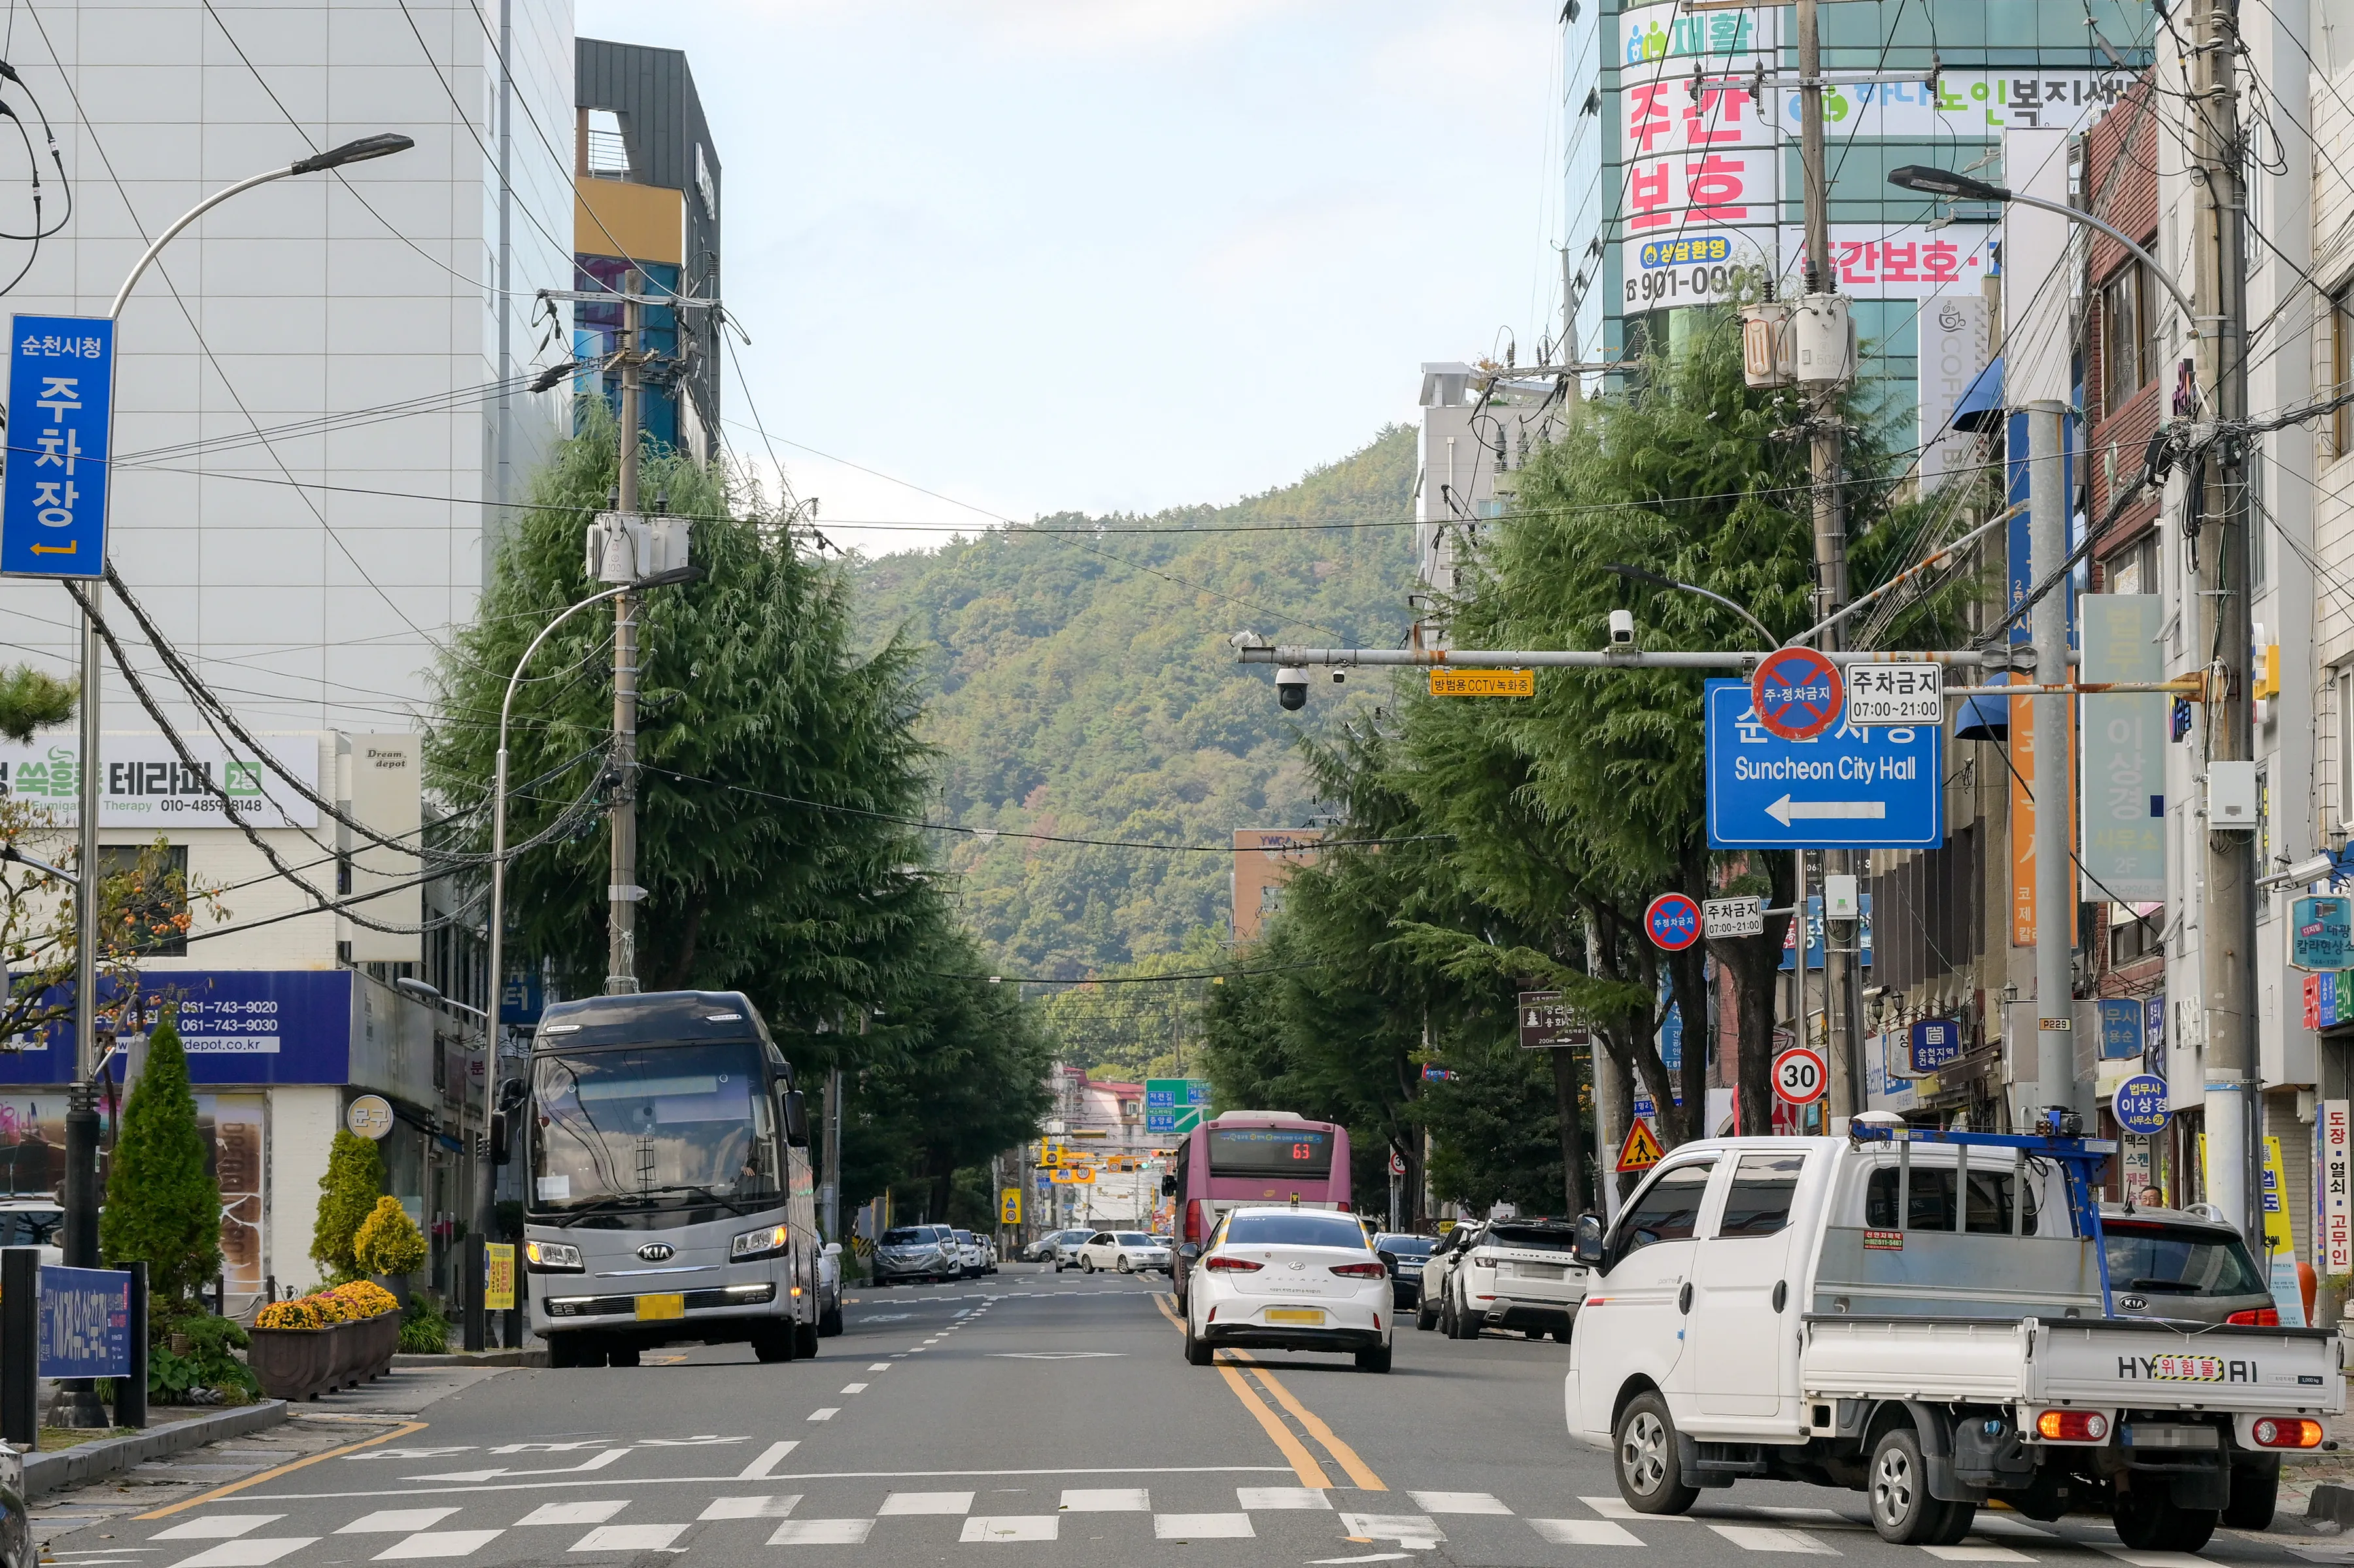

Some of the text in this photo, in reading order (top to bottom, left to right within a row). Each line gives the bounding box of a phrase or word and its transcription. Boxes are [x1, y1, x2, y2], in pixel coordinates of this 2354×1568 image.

[1672, 14, 1753, 59] 재활
[1630, 77, 1750, 151] 주간
[1631, 155, 1747, 230] 보호
[1661, 239, 1726, 263] 상담환영
[21, 335, 101, 359] 순천시청
[32, 377, 82, 528] 주차장
[1853, 670, 1937, 695] 주차금지
[1764, 686, 1830, 703] 주·정차금지
[1853, 702, 1937, 718] 07:00~21:00
[367, 749, 402, 758] Dream
[375, 760, 406, 770] depot
[1735, 755, 1916, 785] Suncheon City Hall
[2107, 716, 2146, 821] 이상경
[110, 762, 211, 796] 테라피
[104, 800, 152, 813] Therapy
[1259, 836, 1291, 846] YWCA
[2095, 830, 2159, 851] 사무소
[2115, 857, 2137, 874] 2F
[1708, 901, 1758, 920] 주차금지
[1654, 916, 1694, 929] 주정차금지
[1709, 920, 1760, 934] 07:00~21:00
[2327, 925, 2351, 938] 대광
[181, 1001, 278, 1014] 061-743-9020
[181, 1018, 278, 1032] 061-743-9030
[2043, 1020, 2066, 1029] P229
[1917, 1048, 1954, 1057] 순천지역
[1783, 1065, 1815, 1087] 30
[2128, 1083, 2161, 1096] 법무사
[2121, 1097, 2168, 1114] 이상경
[352, 1108, 388, 1127] 문구
[2128, 1116, 2153, 1125] 사무소
[2124, 1134, 2149, 1148] 팩스
[1292, 1144, 1310, 1159] 63
[2125, 1153, 2149, 1168] 스캔
[2126, 1172, 2149, 1187] 제본
[2328, 1112, 2348, 1267] 도장 열쇠 고무인
[643, 1246, 669, 1259] KIA
[2124, 1297, 2143, 1308] KIA
[2160, 1359, 2215, 1377] 위험물
